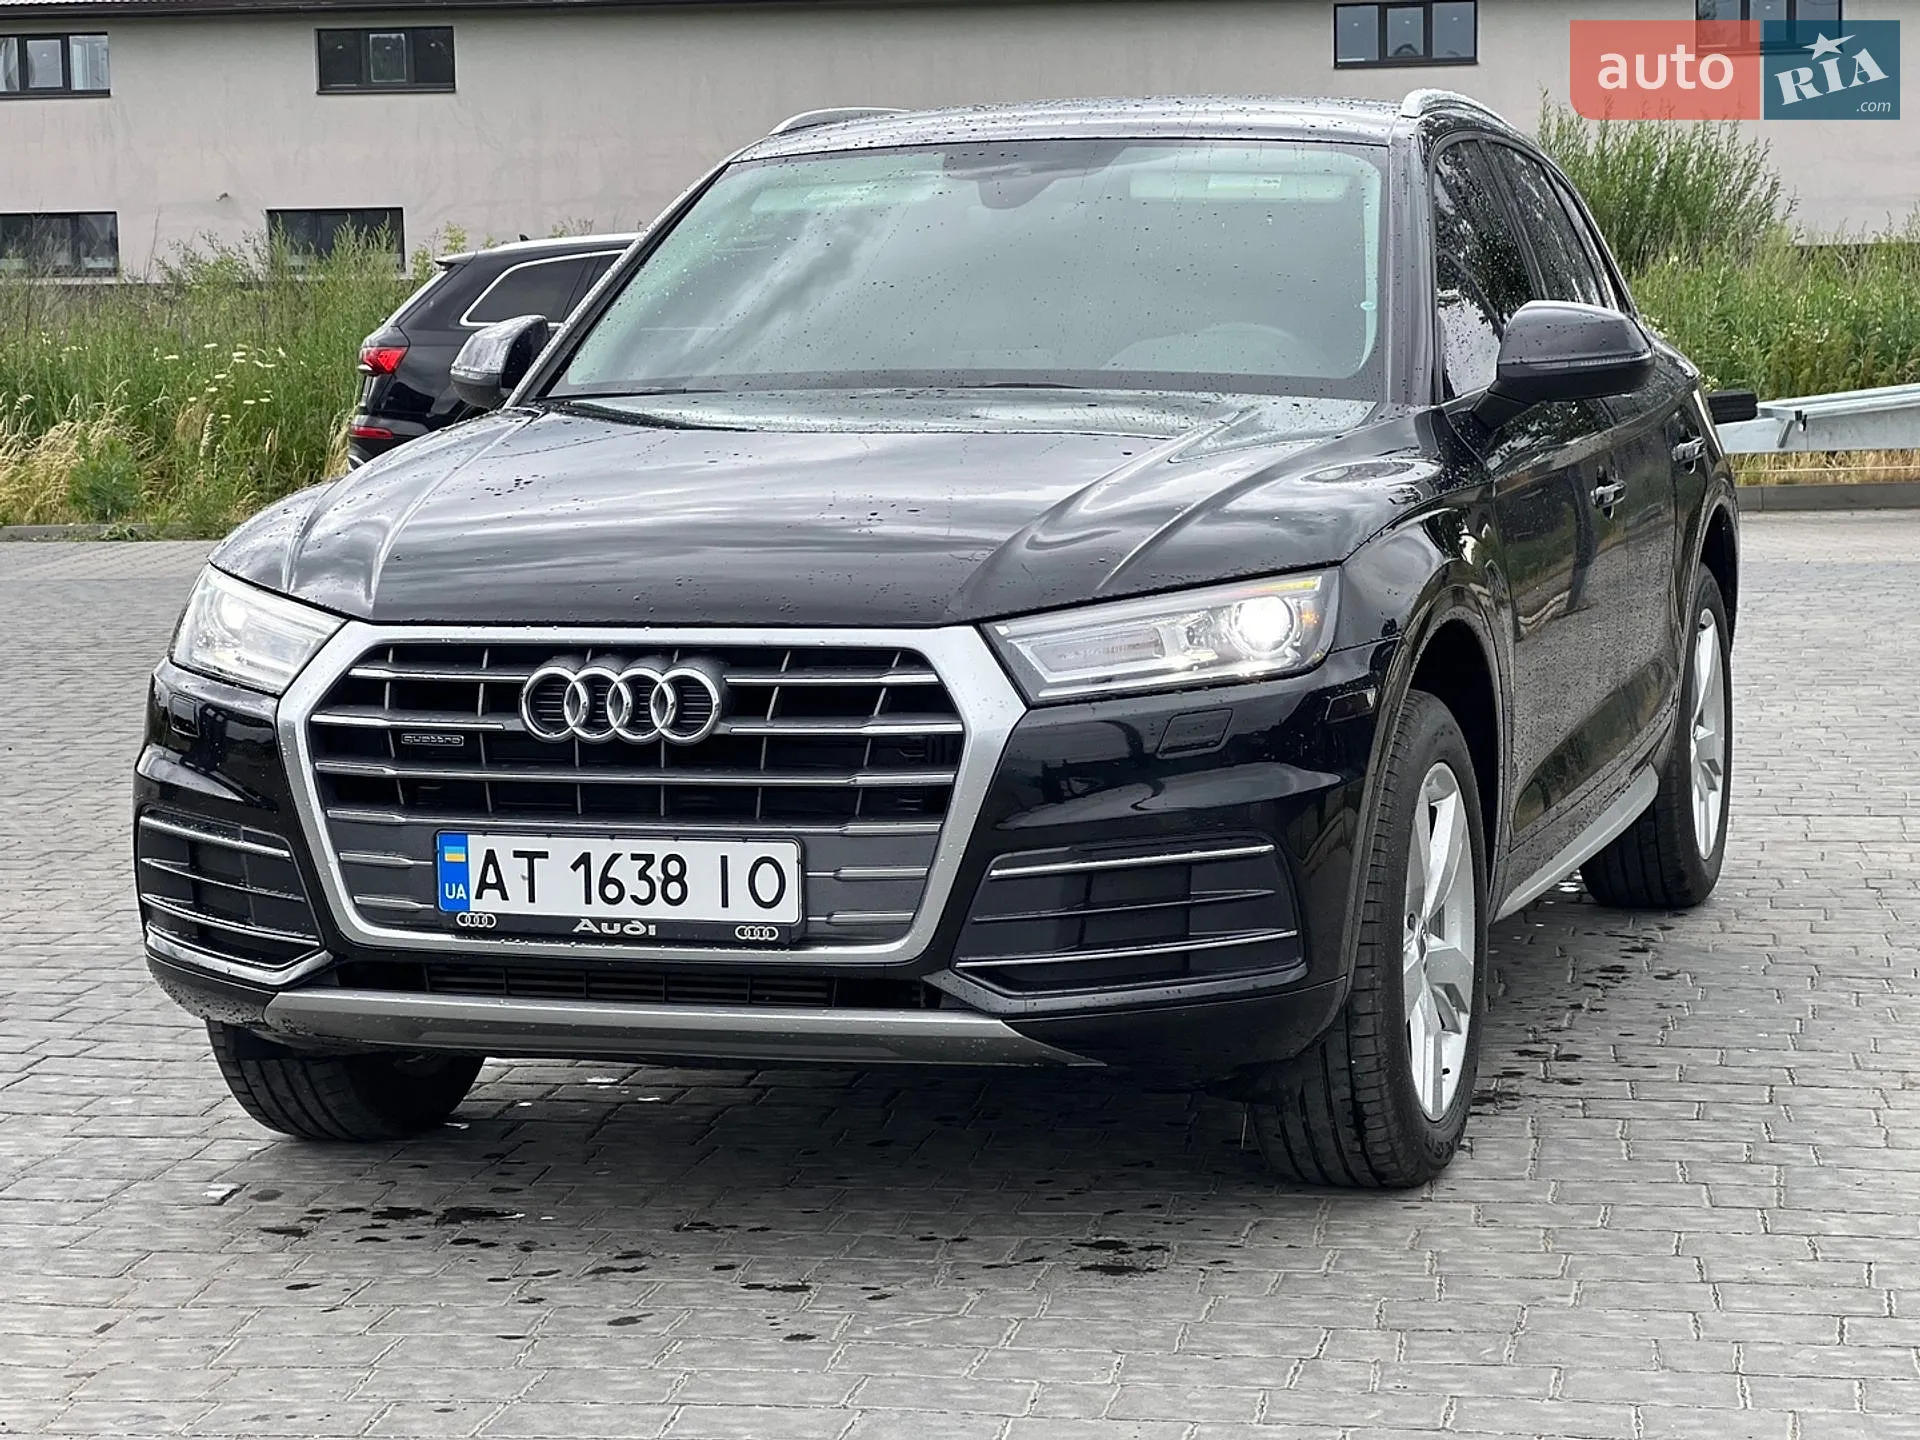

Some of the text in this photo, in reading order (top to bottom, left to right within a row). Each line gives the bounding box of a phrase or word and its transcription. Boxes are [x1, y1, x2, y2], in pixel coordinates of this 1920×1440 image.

[475, 848, 787, 909] AT 1638 IO
[445, 883, 467, 899] UA
[572, 918, 656, 936] Audi
